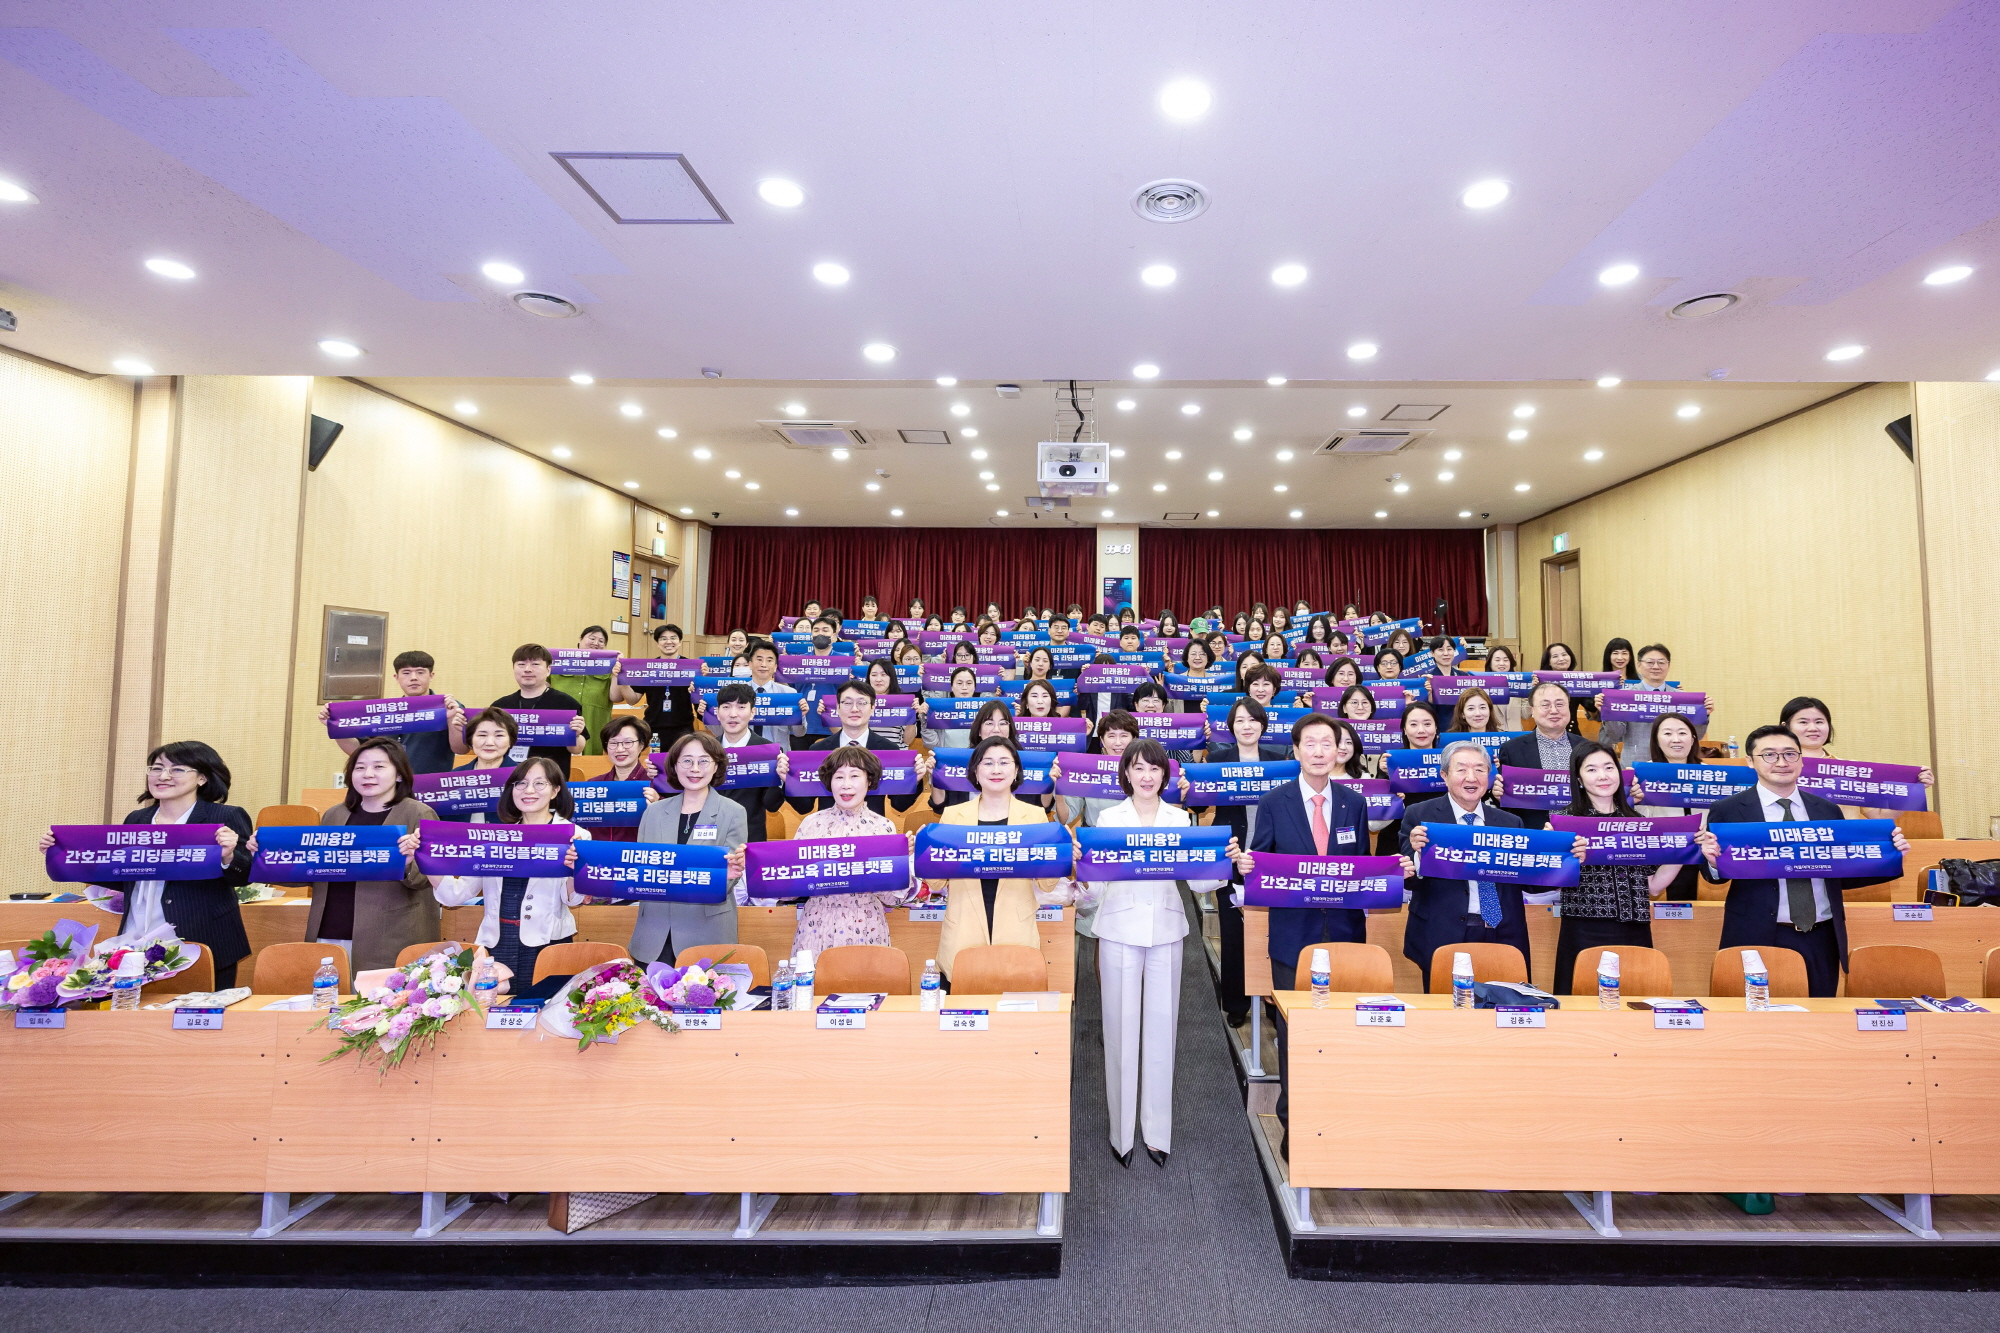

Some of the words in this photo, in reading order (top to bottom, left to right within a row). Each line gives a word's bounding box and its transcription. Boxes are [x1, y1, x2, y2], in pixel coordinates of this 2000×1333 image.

[572, 659, 611, 667] 리딩플랫폼
[1402, 665, 1428, 676] 간호교육
[755, 697, 771, 705] 융합
[1634, 694, 1672, 703] 미래융합
[366, 702, 408, 714] 미래융합
[1611, 703, 1647, 712] 간호교육
[1650, 704, 1696, 715] 리딩플랫폼
[339, 716, 381, 728] 간호교육
[384, 711, 435, 724] 리딩플랫폼
[1015, 722, 1052, 732] 미래융합
[1151, 729, 1196, 738] 리딩플랫폼
[1030, 734, 1076, 744] 리딩플랫폼
[1364, 733, 1403, 743] 리딩플랫
[1098, 760, 1119, 771] 미래
[1423, 754, 1441, 764] 미래
[727, 763, 769, 775] 딩플랫폼
[945, 766, 968, 777] 간호
[1222, 767, 1264, 778] 미래융합
[1398, 768, 1437, 778] 간호교육
[1678, 769, 1727, 782] 미래융합
[1818, 764, 1873, 778] 미래융합
[440, 775, 491, 787] 미래융합
[800, 771, 820, 782] 간호
[1069, 772, 1112, 785] 간호교육
[1544, 774, 1570, 783] 미래
[465, 787, 504, 799] 리딩플
[570, 788, 608, 798] 래융합
[1194, 781, 1237, 792] 간호교육
[1513, 784, 1559, 796] 간호교육
[1645, 782, 1693, 794] 간호교육
[1697, 784, 1752, 796] 리딩플랫
[1797, 777, 1836, 789] 호교육
[1840, 779, 1909, 796] 리딩플랫폼
[583, 801, 637, 813] 리딩플랫폼
[1366, 797, 1391, 807] 플랫폼
[1598, 821, 1653, 832] 미래융합
[107, 831, 167, 845] 미래융합
[300, 832, 356, 847] 미래융합
[467, 829, 523, 842] 미래융합
[966, 831, 1022, 844] 미래융합
[1126, 833, 1181, 847] 미래융합
[1769, 827, 1834, 842] 미래융합
[1473, 833, 1529, 850] 미래융합
[1586, 836, 1617, 850] 교육
[1621, 836, 1688, 849] 리딩플랫폼
[66, 850, 126, 864] 간호교육
[131, 848, 206, 863] 리딩플랫폼
[264, 850, 320, 864] 간호교육
[324, 849, 390, 864] 리딩플랫폼
[430, 844, 486, 859] 간호교육
[490, 845, 559, 860] 리딩플랫폼
[621, 850, 676, 865] 미래융합
[799, 844, 856, 860] 미래융합
[930, 848, 985, 862] 간호교육
[990, 847, 1057, 862] 리딩플랫폼
[1091, 850, 1145, 864] 간호교육
[1150, 850, 1216, 862] 리딩플랫폼
[1434, 847, 1491, 865] 간호교육
[1495, 852, 1562, 868] 리딩플랫폼
[1731, 847, 1794, 861] 간호교육
[1800, 845, 1882, 859] 리딩플랫폼
[587, 865, 639, 882] 간호교육
[644, 869, 711, 885] 리딩플랫폼
[762, 865, 819, 881] 간호교육
[823, 860, 894, 876] 리딩플랫폼
[1298, 862, 1354, 876] 미래융합
[1261, 876, 1316, 892] 간호교육
[1320, 878, 1387, 893] 리딩플랫폼
